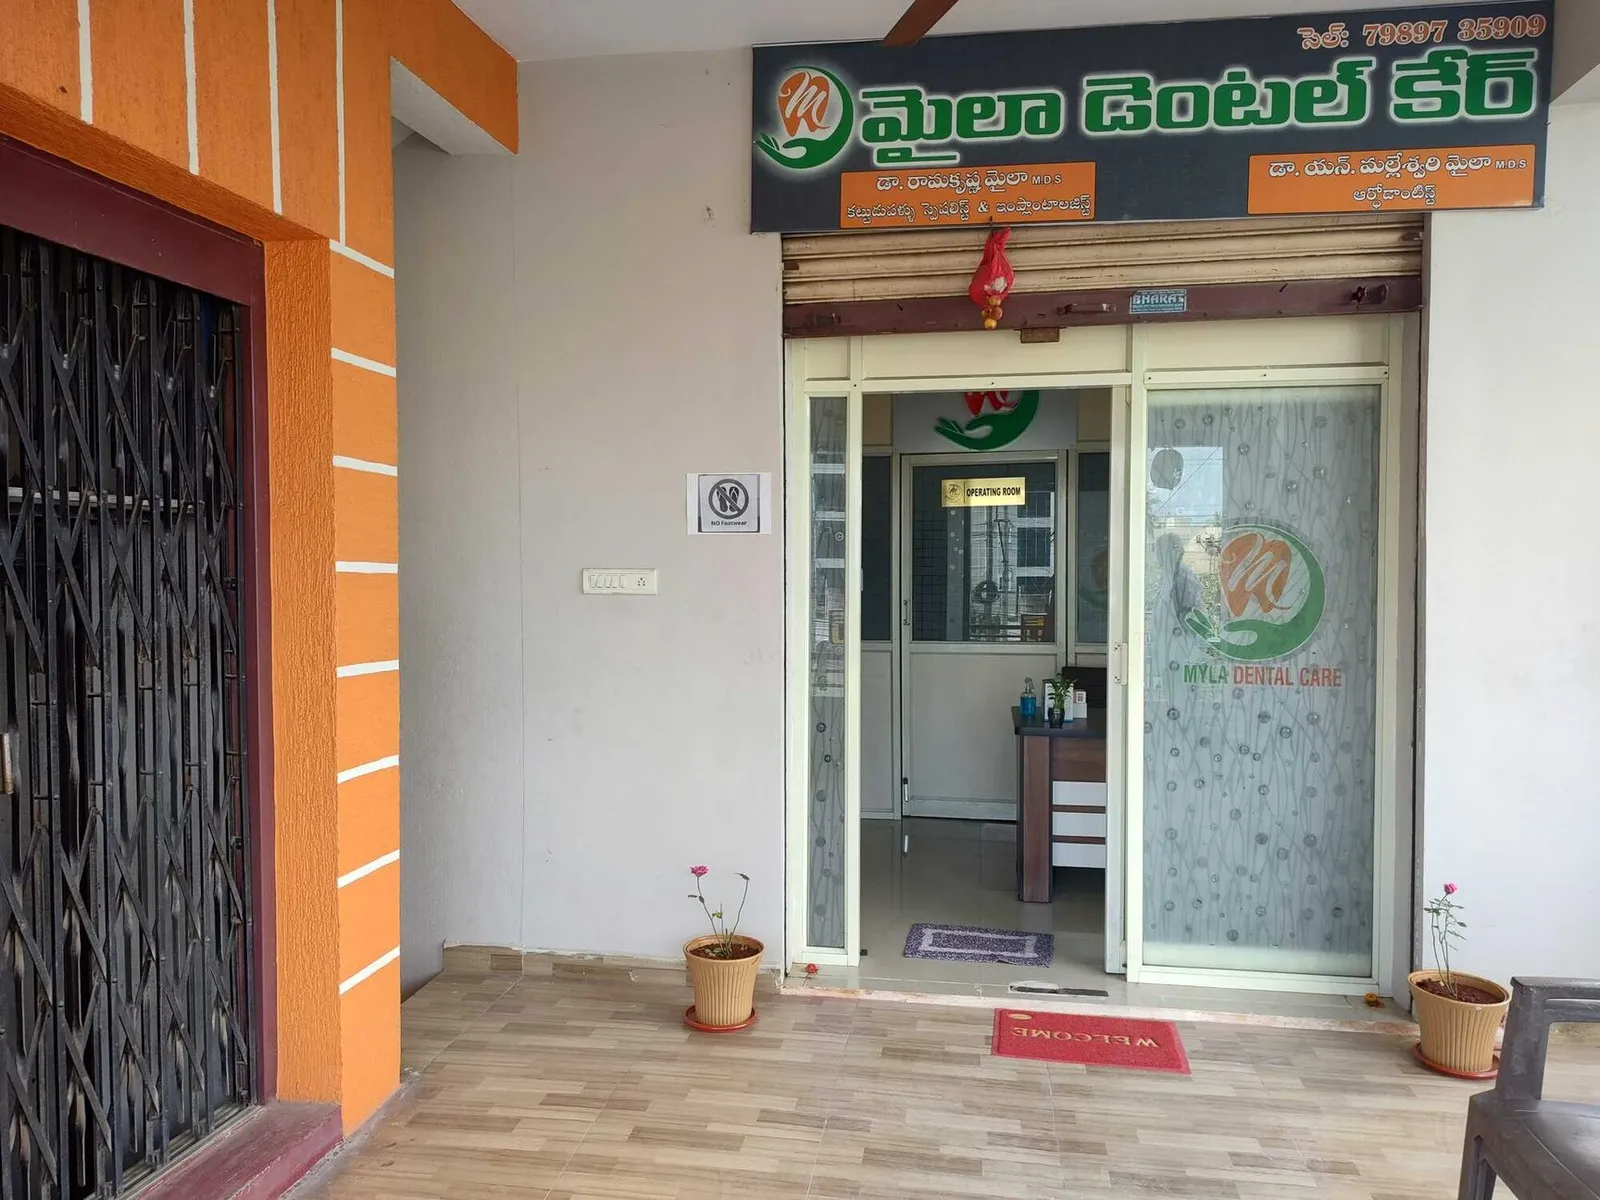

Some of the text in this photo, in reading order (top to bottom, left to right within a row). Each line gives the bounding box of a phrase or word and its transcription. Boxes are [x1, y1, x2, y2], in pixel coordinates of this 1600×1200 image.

[1297, 14, 1546, 50] సెల్: 79897 35909
[861, 48, 1539, 165] మైలా డెంటల్ కేర్
[1269, 152, 1527, 179] డా. యన్. మల్లేశ్వరి మైలా M.D.S
[877, 170, 1062, 194] డా. రామకృష్ణ మైలా M.D.S
[977, 200, 989, 213] &
[966, 487, 1021, 497] OPERATING ROOM
[1183, 664, 1342, 688] MYLA DENTAL CARE
[1011, 1027, 1160, 1047] WELCOME
